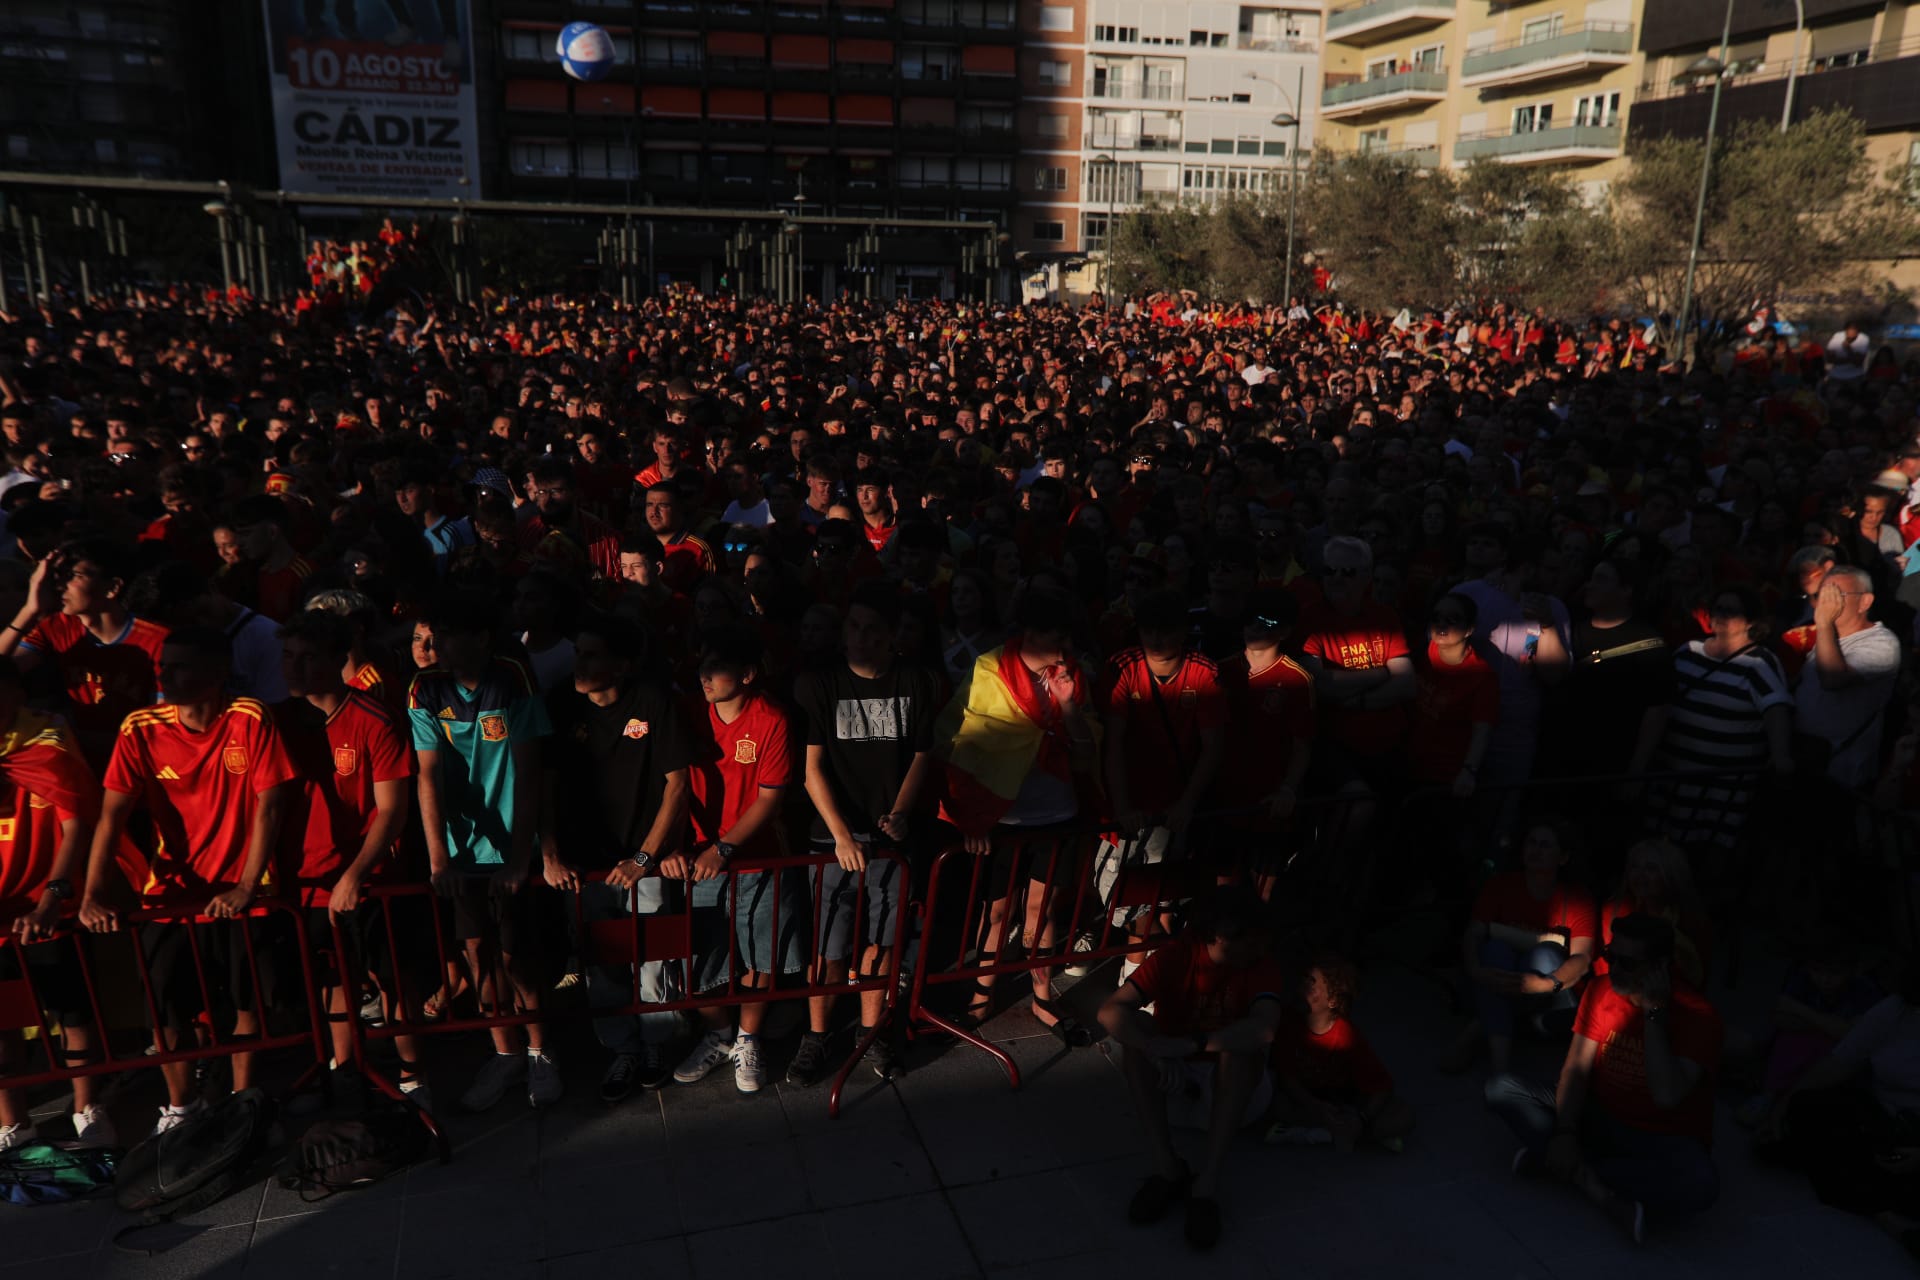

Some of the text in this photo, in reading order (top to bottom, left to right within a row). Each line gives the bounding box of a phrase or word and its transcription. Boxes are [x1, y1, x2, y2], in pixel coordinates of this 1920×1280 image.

[289, 47, 341, 87] 10
[294, 107, 461, 148] CÁDIZ
[295, 145, 463, 162] Muelle Reina Victoria
[296, 160, 464, 177] VENTAS DE ENTRADAS
